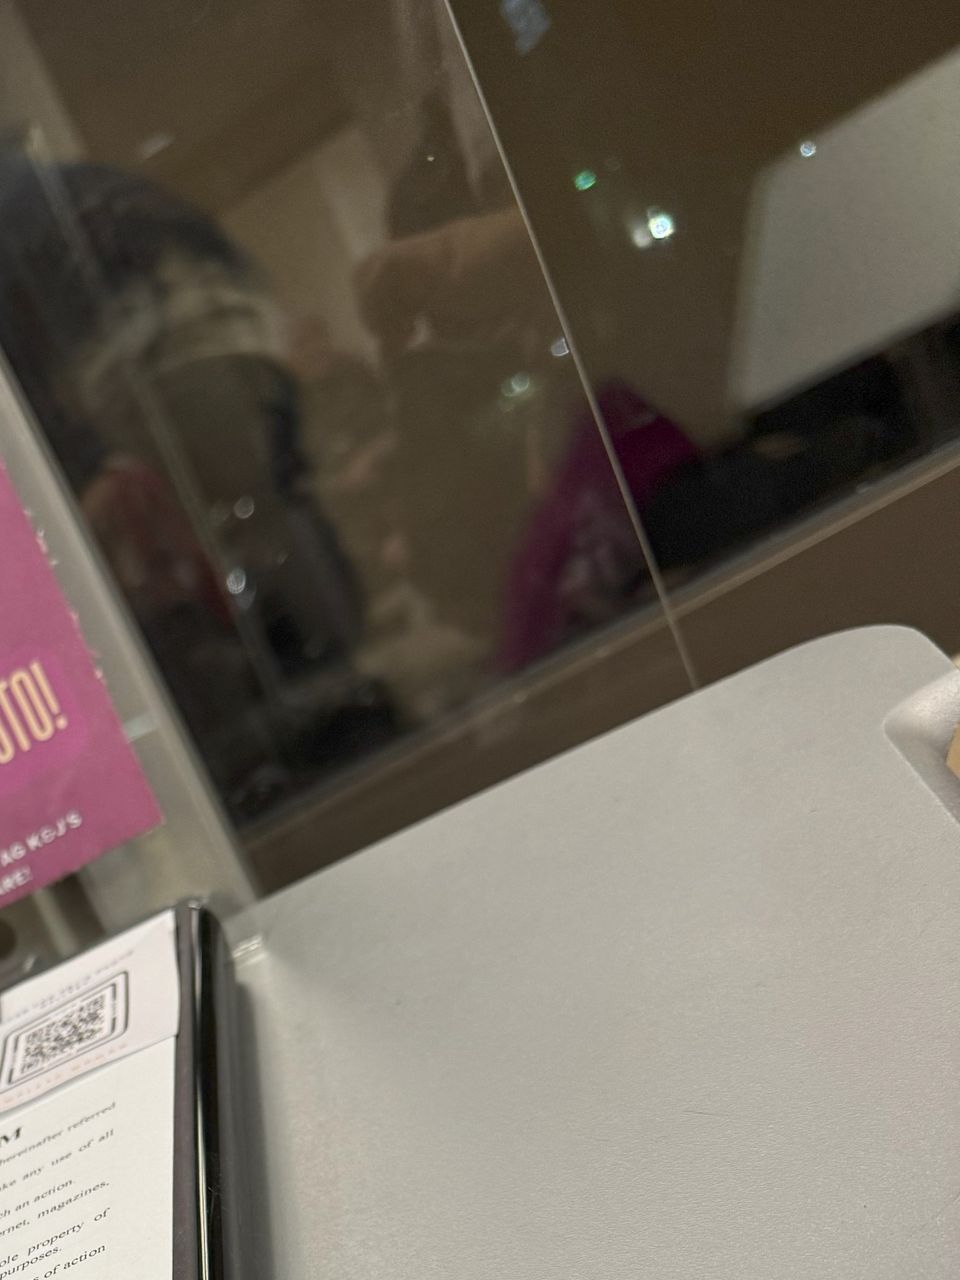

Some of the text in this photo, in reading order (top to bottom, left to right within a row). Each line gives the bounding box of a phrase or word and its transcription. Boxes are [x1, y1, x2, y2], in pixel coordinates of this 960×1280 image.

[67, 1100, 116, 1132] referred
[21, 1165, 42, 1183] any
[50, 1150, 72, 1167] use
[78, 1137, 94, 1153] of
[97, 1127, 114, 1143] all
[14, 1199, 29, 1212] an
[36, 1175, 110, 1222] magazines,
[26, 1218, 84, 1257] property
[93, 1206, 110, 1223] of
[43, 1262, 60, 1280] of
[62, 1240, 106, 1271] action
